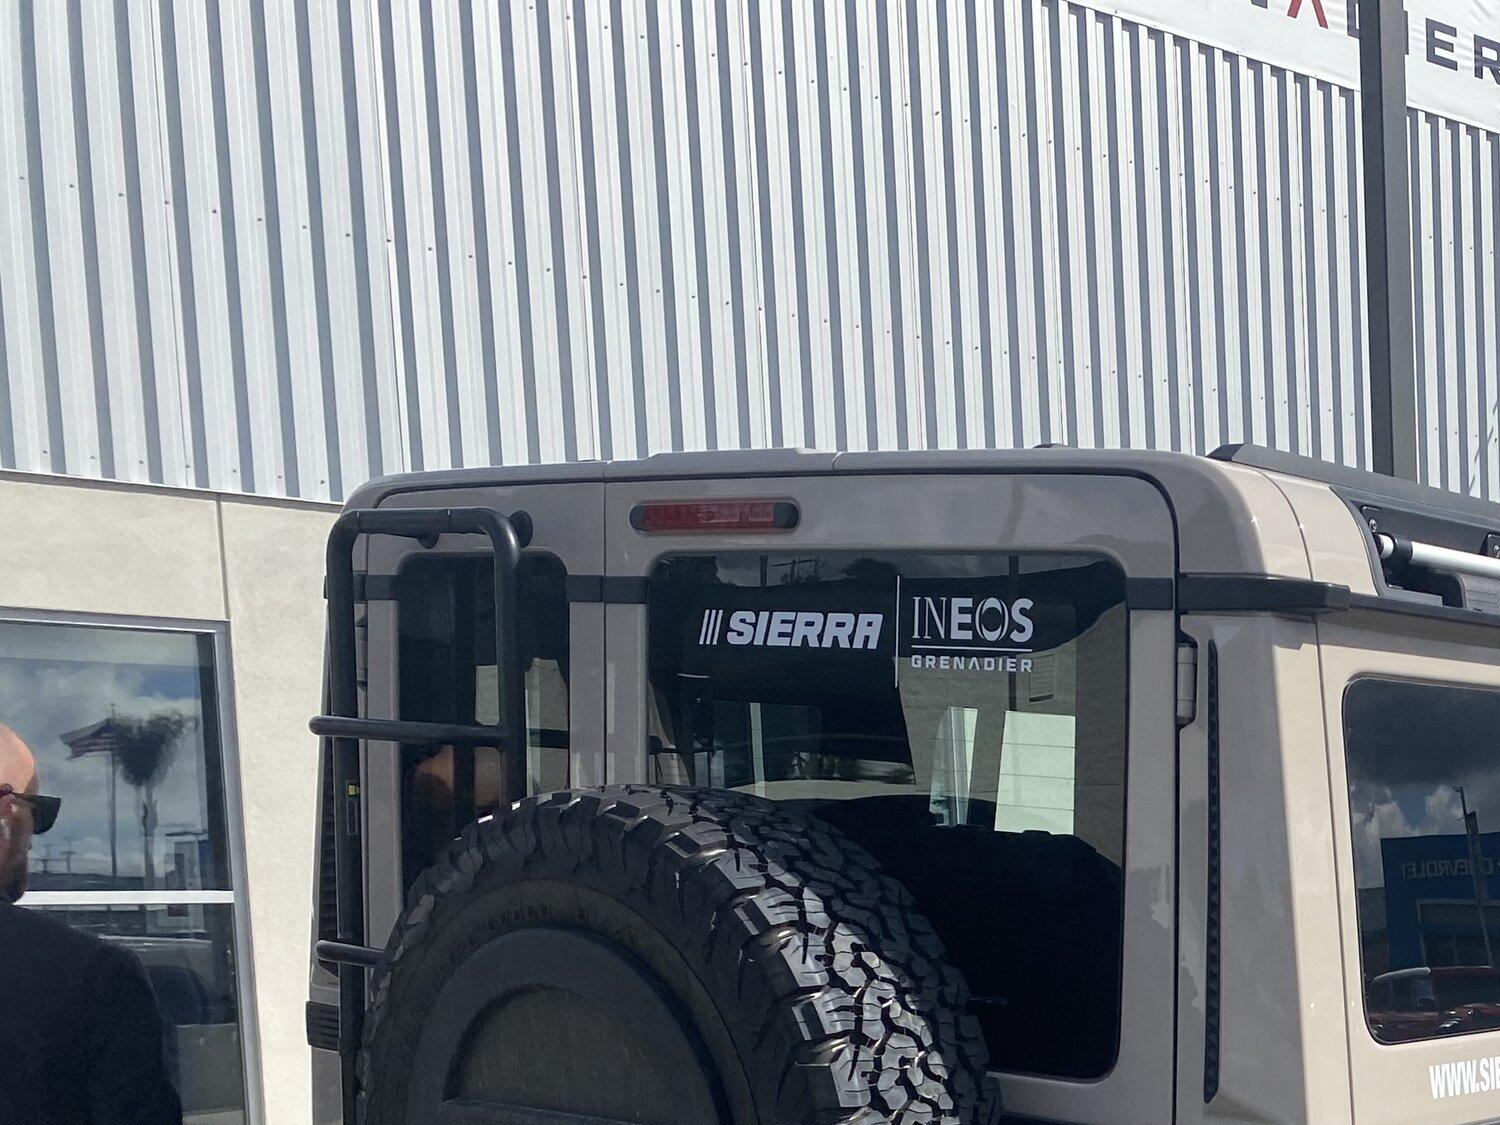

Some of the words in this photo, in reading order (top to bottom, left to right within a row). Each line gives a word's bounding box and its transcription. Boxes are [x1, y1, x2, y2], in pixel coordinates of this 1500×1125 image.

[726, 610, 884, 650] SIERRA
[911, 596, 1034, 642] INEOS
[911, 654, 1033, 673] GRENADIER
